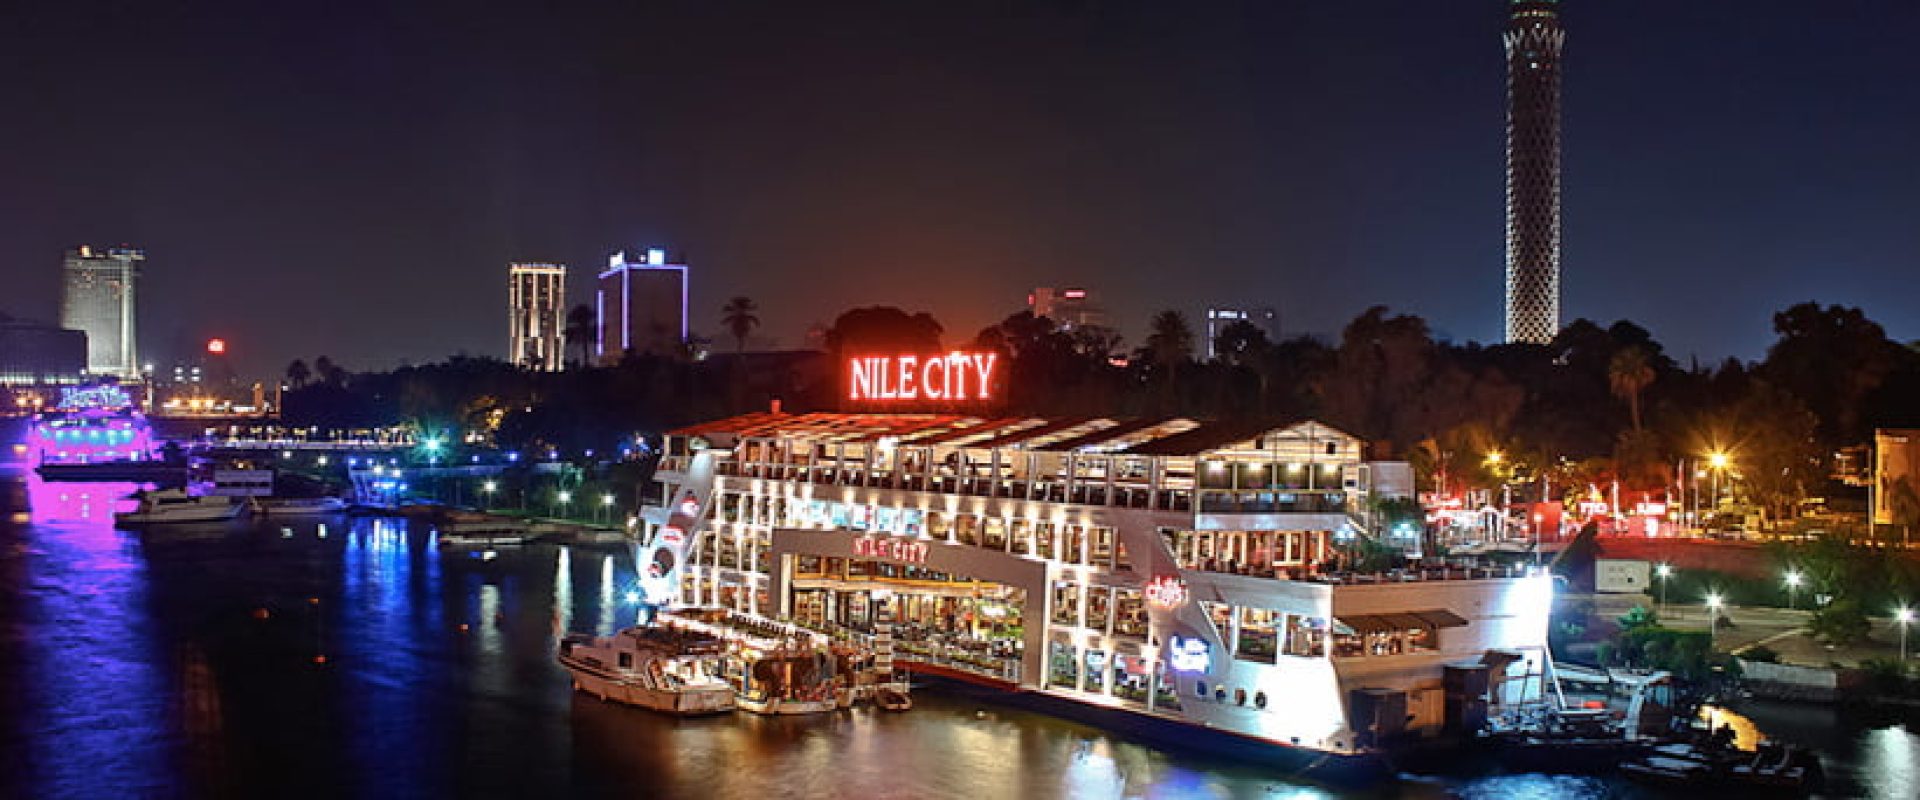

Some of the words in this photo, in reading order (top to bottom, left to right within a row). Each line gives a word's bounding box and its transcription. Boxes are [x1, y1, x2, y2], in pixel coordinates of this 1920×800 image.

[849, 354, 918, 400] NILE
[923, 351, 998, 400] CITY
[851, 539, 888, 556] NILE
[893, 542, 928, 563] CITY
